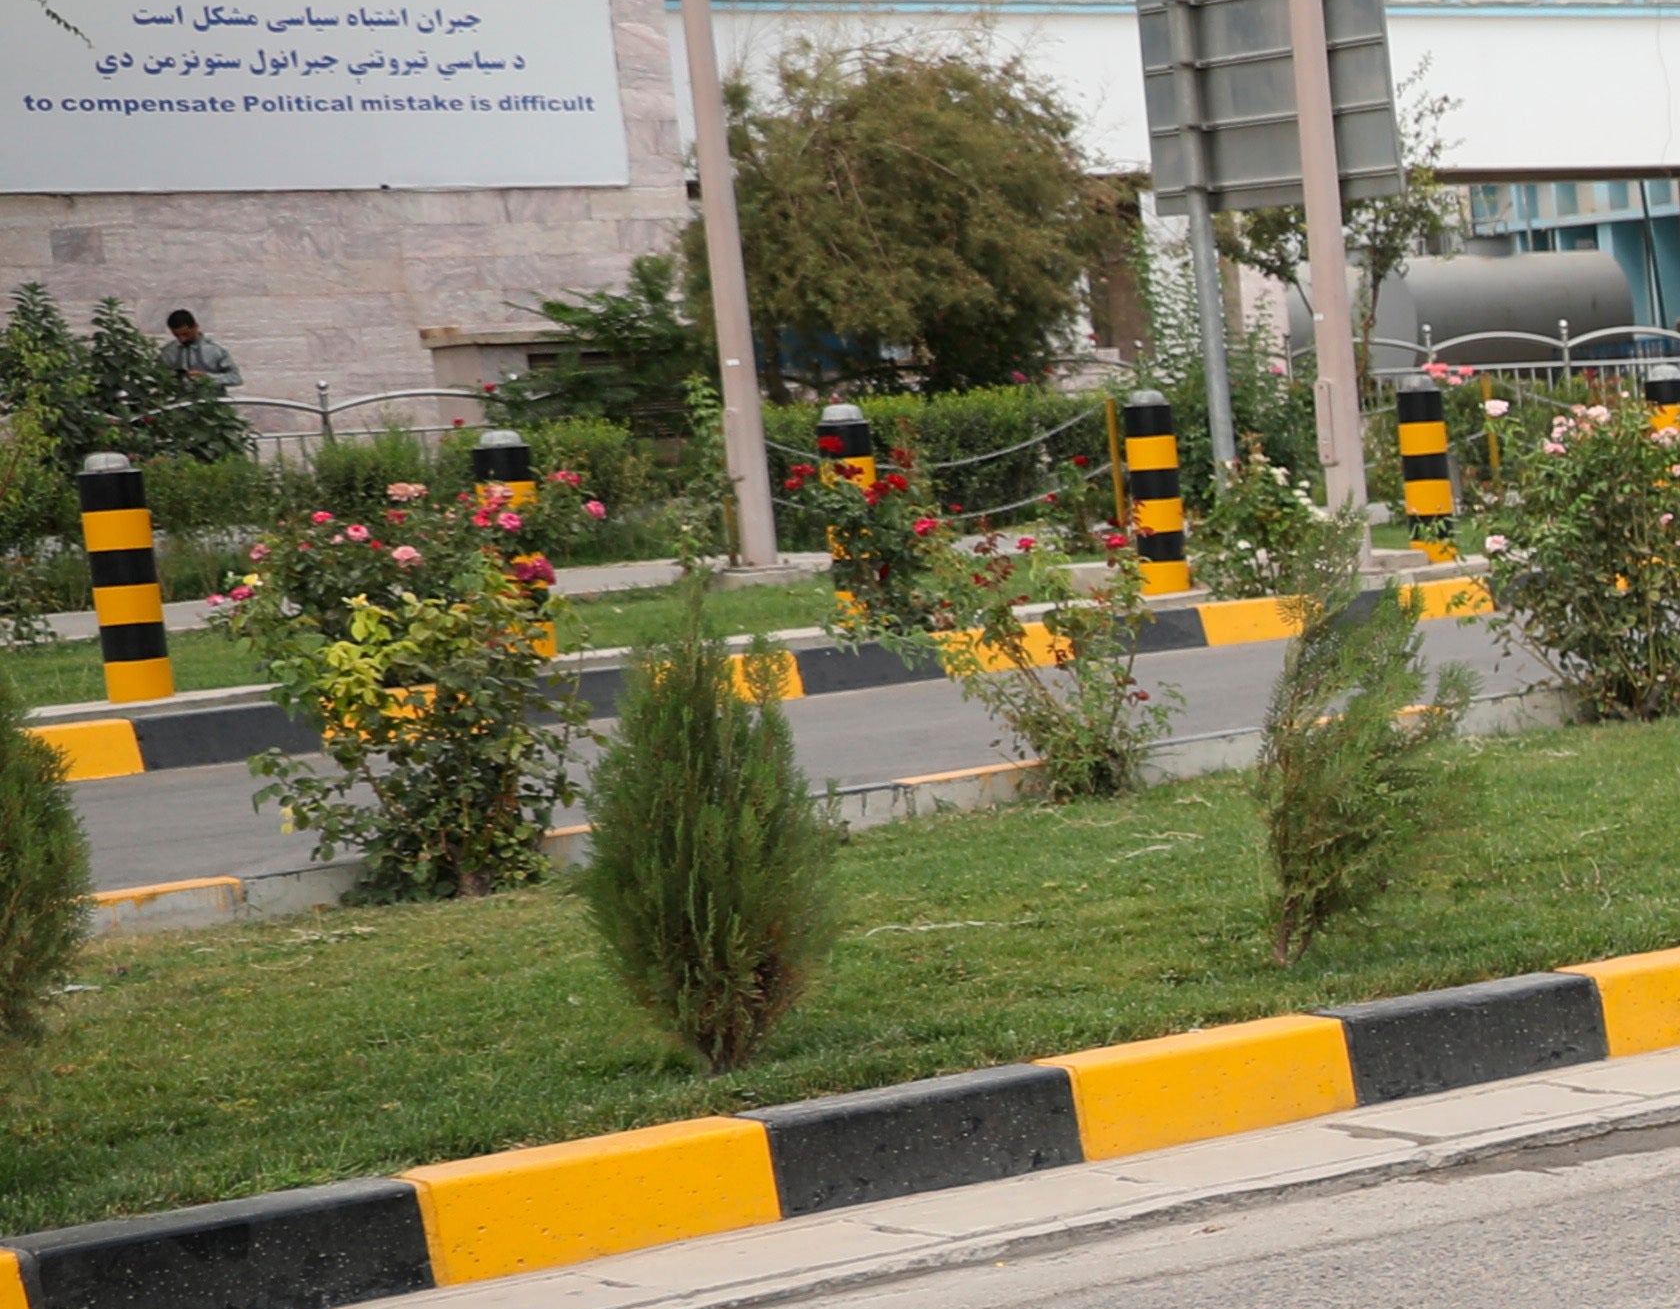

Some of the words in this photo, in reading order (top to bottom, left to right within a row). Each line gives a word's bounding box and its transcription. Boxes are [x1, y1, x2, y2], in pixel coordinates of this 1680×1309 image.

[132, 6, 184, 25] است
[193, 6, 258, 32] مشکل
[347, 8, 408, 31] اشتباه
[416, 8, 481, 34] جبران
[23, 94, 53, 112] to
[61, 96, 236, 116] compensate
[243, 94, 353, 112] Political
[360, 94, 464, 112] mistake
[471, 94, 492, 112] is
[498, 94, 595, 112] difficult
